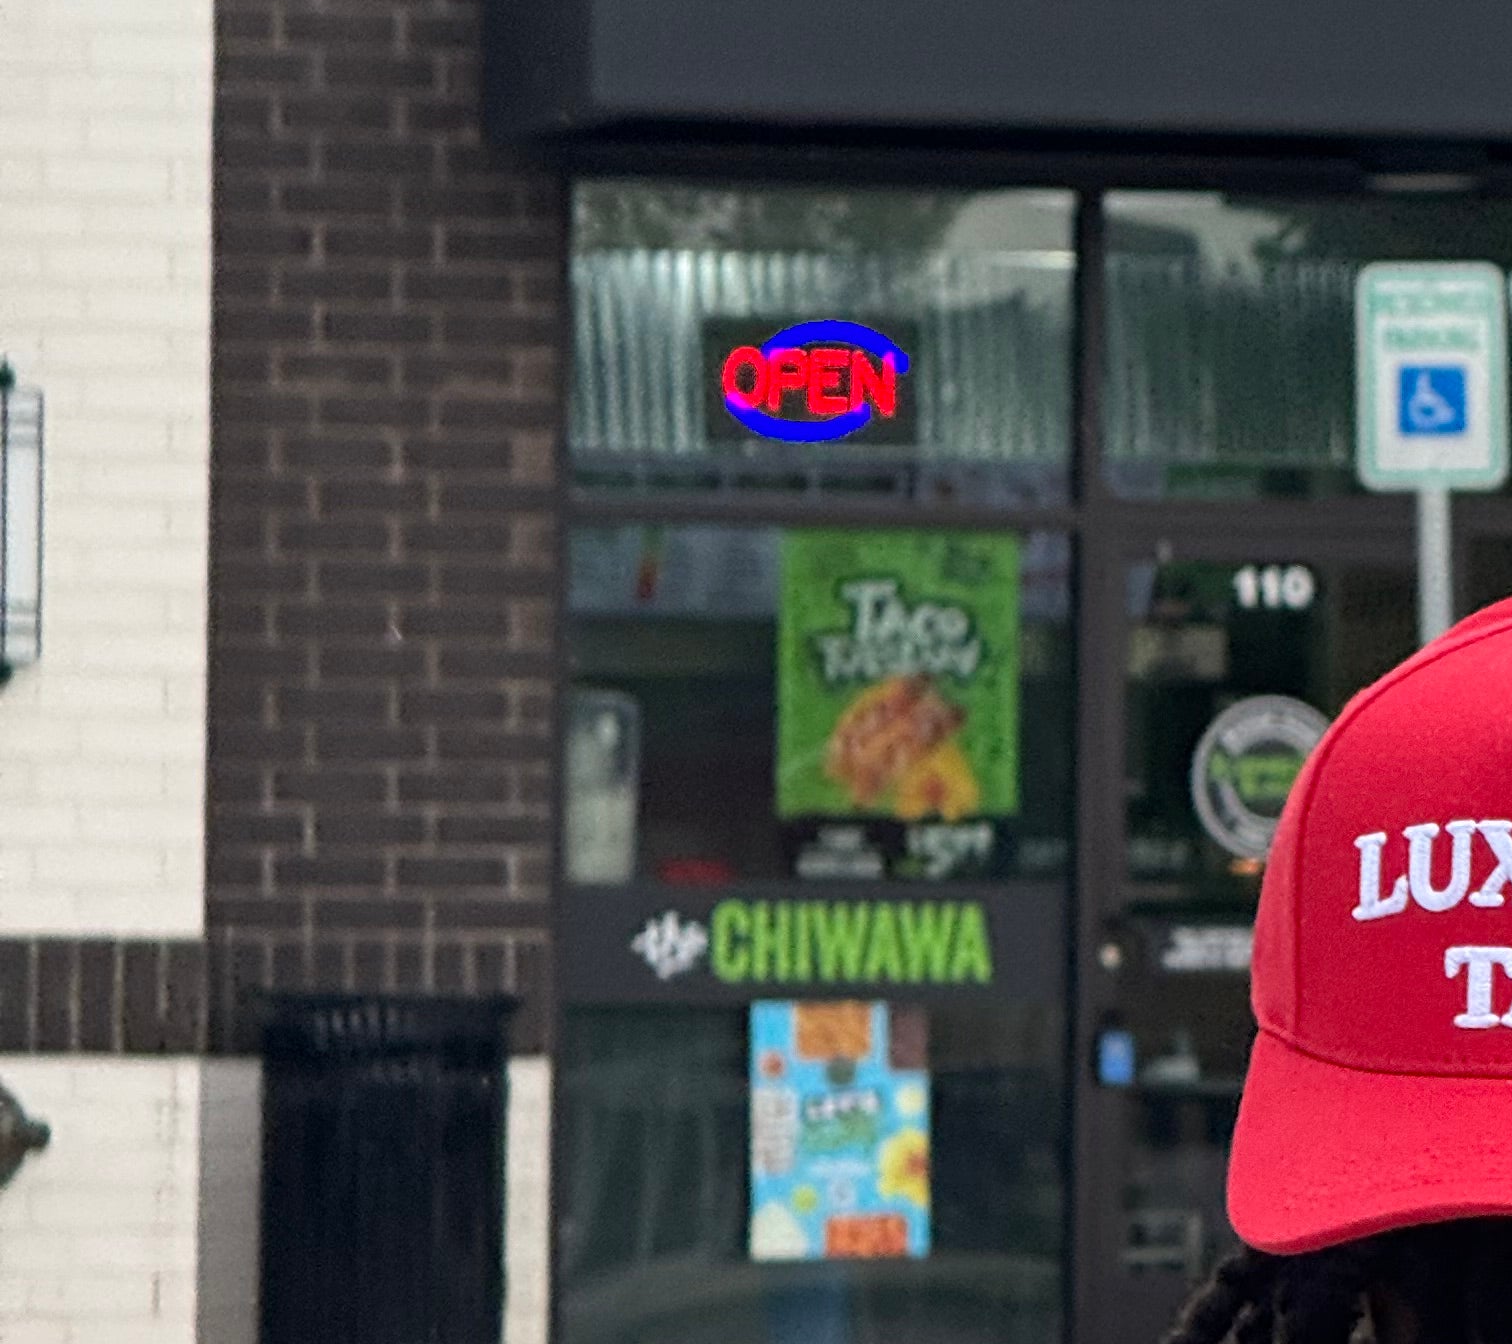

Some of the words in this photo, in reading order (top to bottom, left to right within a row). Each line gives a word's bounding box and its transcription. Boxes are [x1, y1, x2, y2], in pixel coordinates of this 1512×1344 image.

[722, 344, 897, 418] OPEN
[1233, 563, 1316, 610] 110
[710, 898, 993, 984] CHIWAWA
